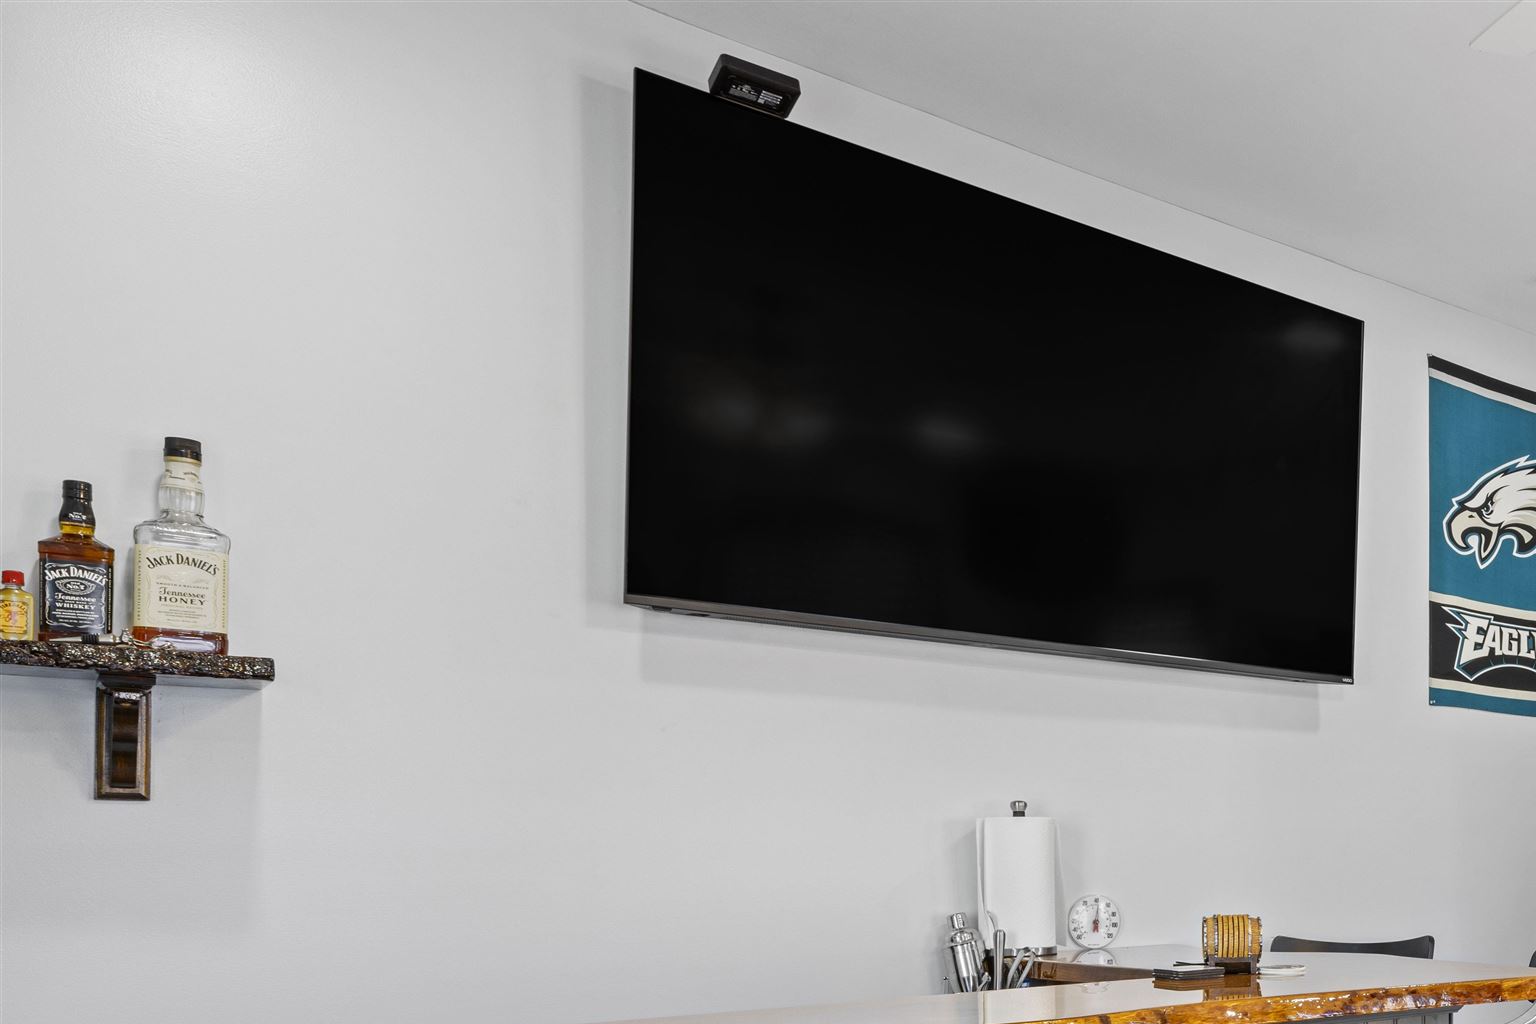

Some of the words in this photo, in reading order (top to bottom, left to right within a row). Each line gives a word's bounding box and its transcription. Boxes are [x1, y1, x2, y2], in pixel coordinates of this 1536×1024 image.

[146, 554, 175, 569] JACK
[176, 553, 220, 576] DANIEL'S
[44, 567, 70, 581] JACK
[70, 566, 109, 586] DANIEL'S
[159, 586, 206, 599] Tennessee
[55, 602, 96, 610] WHISKEY
[159, 595, 208, 606] HONEY
